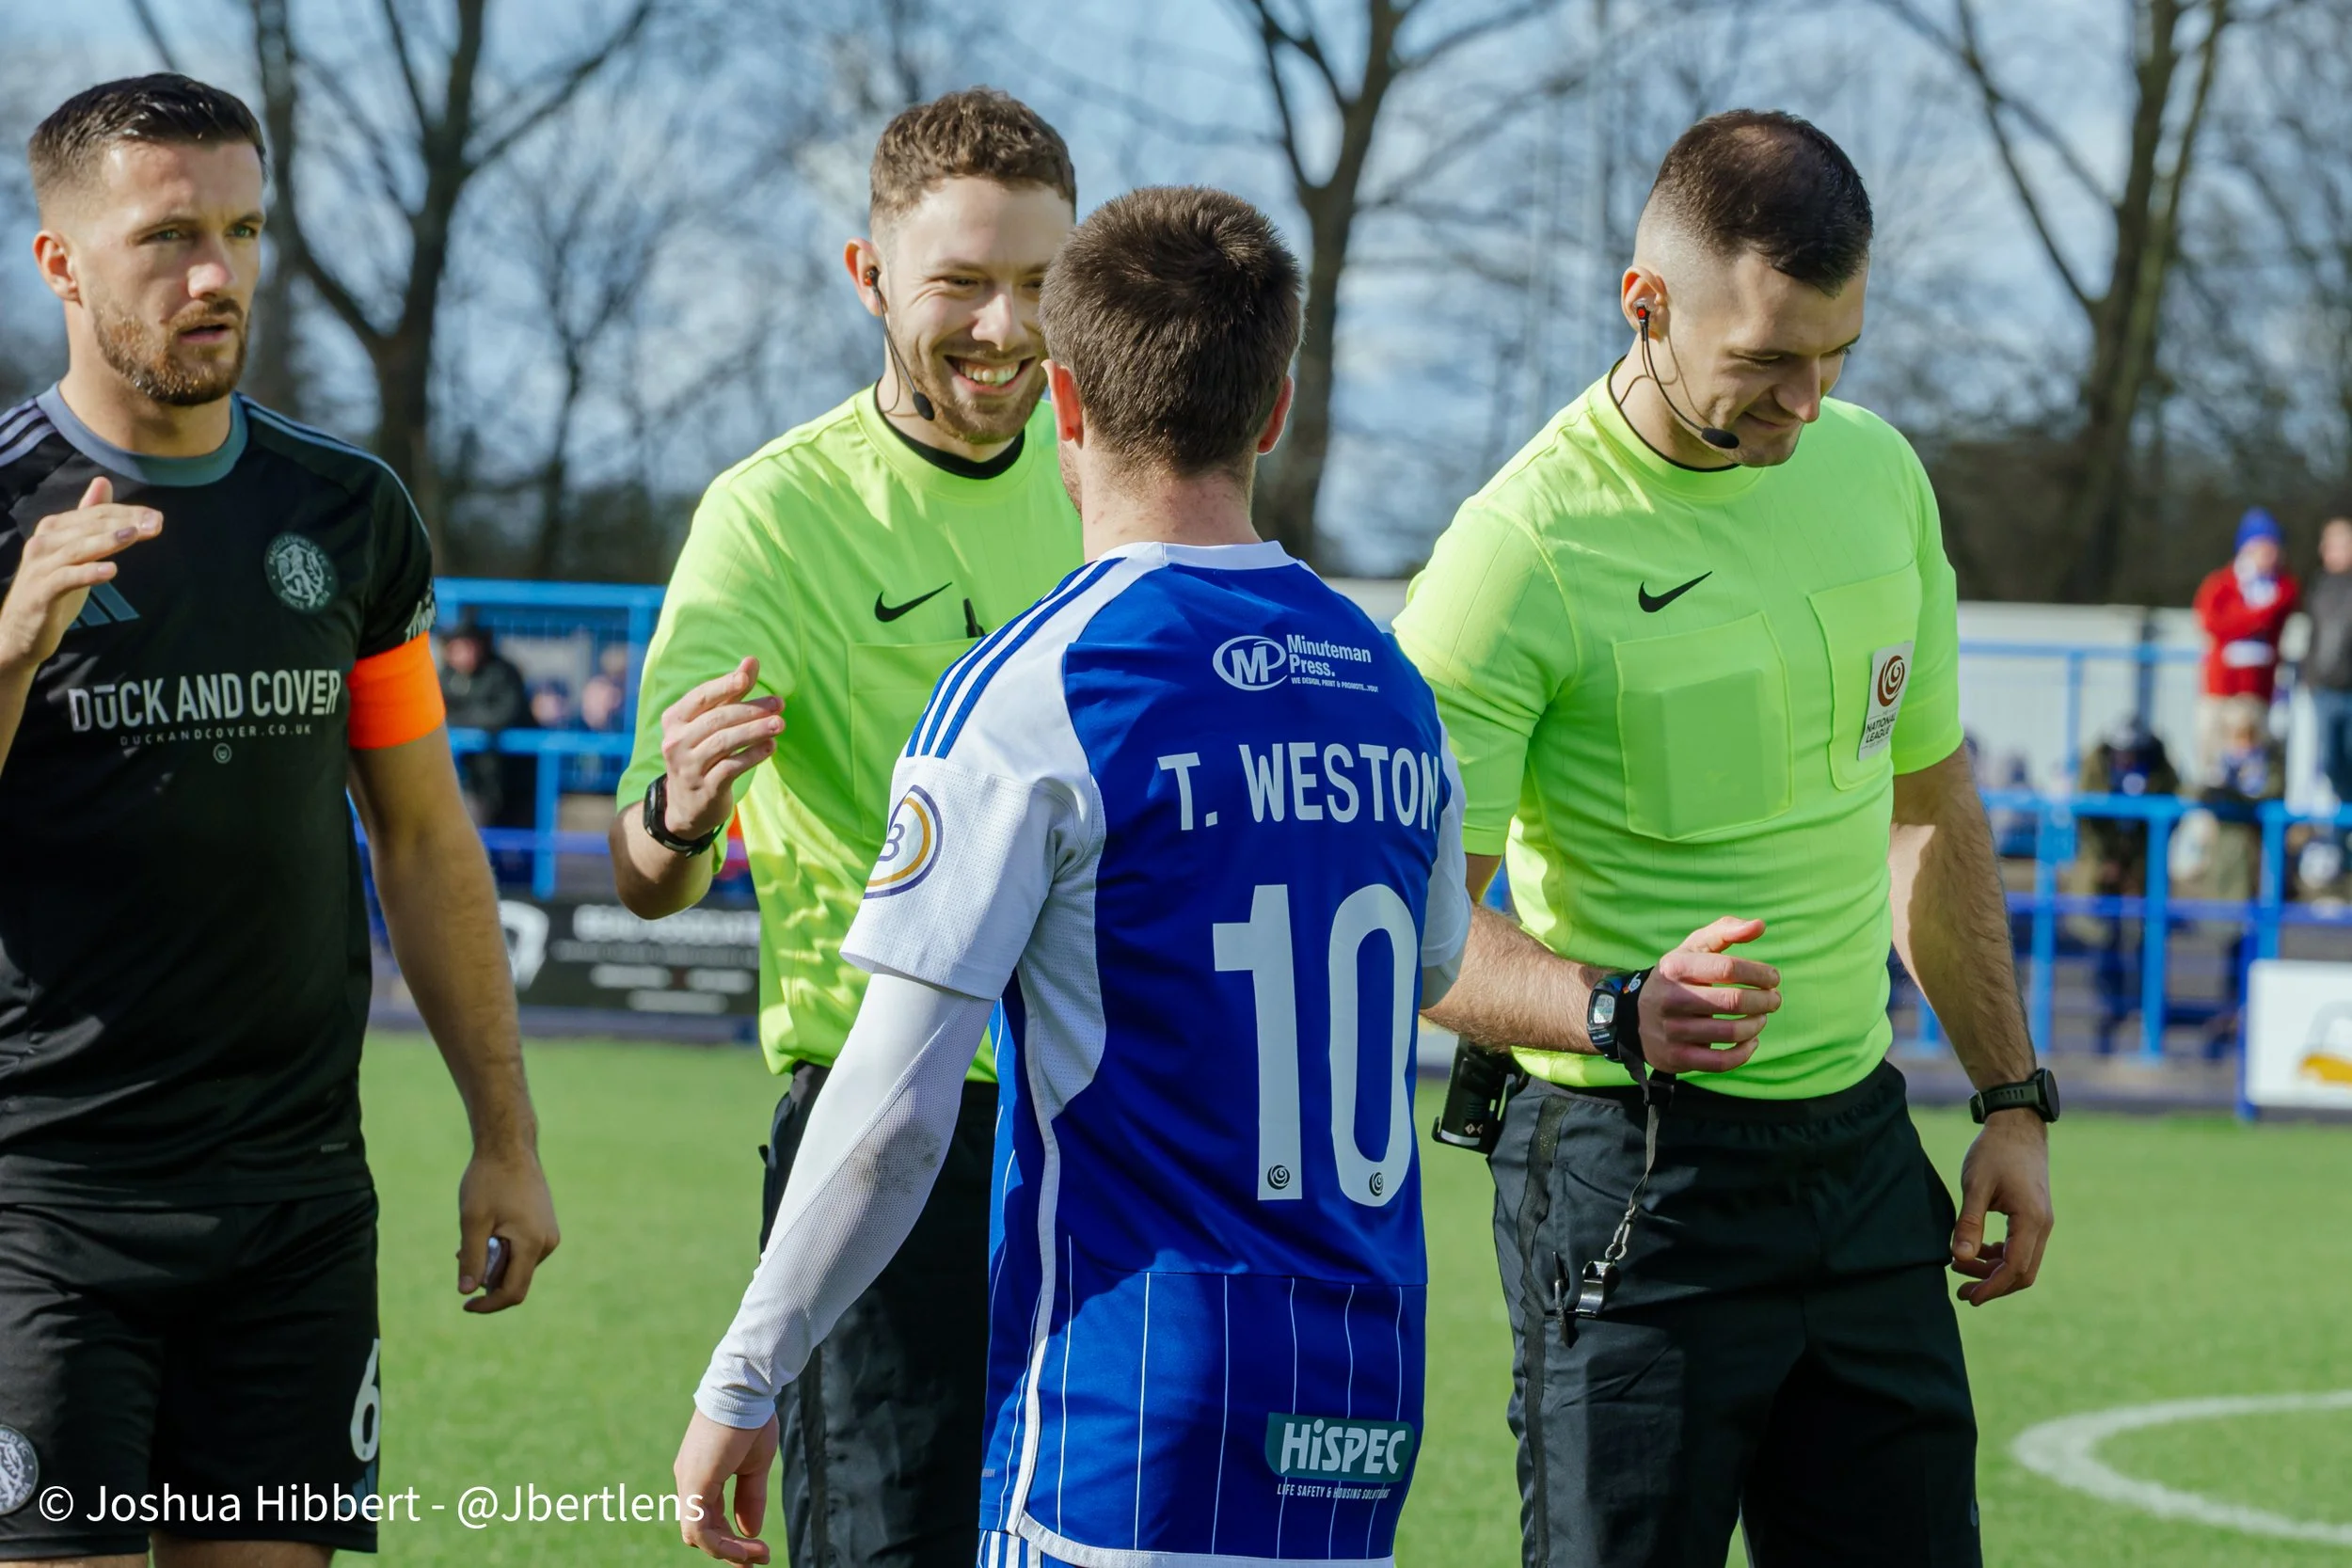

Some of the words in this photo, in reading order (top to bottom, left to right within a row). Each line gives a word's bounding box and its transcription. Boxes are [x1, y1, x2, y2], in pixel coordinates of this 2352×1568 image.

[1286, 634, 1372, 663] Minuteman
[1289, 654, 1336, 677] Press.
[177, 673, 244, 722] AND
[250, 669, 342, 717] COVER
[119, 723, 311, 746] DUCKANDCOVER.CO.UK
[1865, 724, 1891, 743] LEAGUE
[1866, 711, 1897, 734] NATIONAL
[1156, 752, 1218, 831] T.
[1238, 741, 1439, 832] WESTON
[1213, 883, 1418, 1207] 10
[350, 1338, 381, 1463] 6
[1277, 1483, 1295, 1497] LIFE
[1296, 1484, 1326, 1497] SAFETY
[1326, 1486, 1332, 1498] &
[1332, 1487, 1362, 1499] HOUSING
